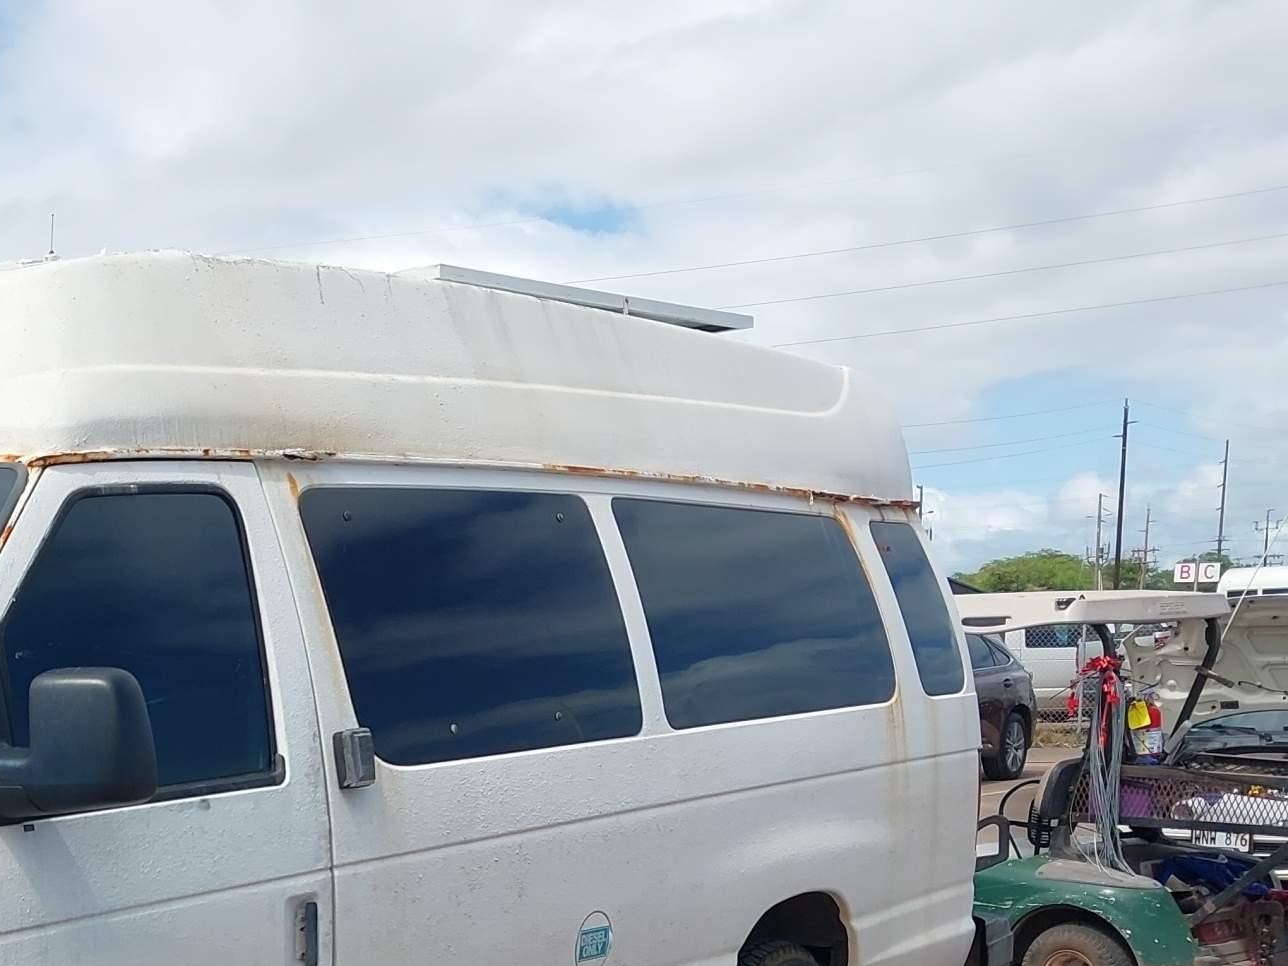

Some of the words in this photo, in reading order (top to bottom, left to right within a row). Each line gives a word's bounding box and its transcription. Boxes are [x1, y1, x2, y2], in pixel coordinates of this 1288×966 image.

[1179, 564, 1191, 580] B
[1204, 564, 1215, 580] C
[1224, 831, 1248, 847] 876
[581, 930, 607, 946] DIESEL
[582, 942, 604, 957] ONLY
